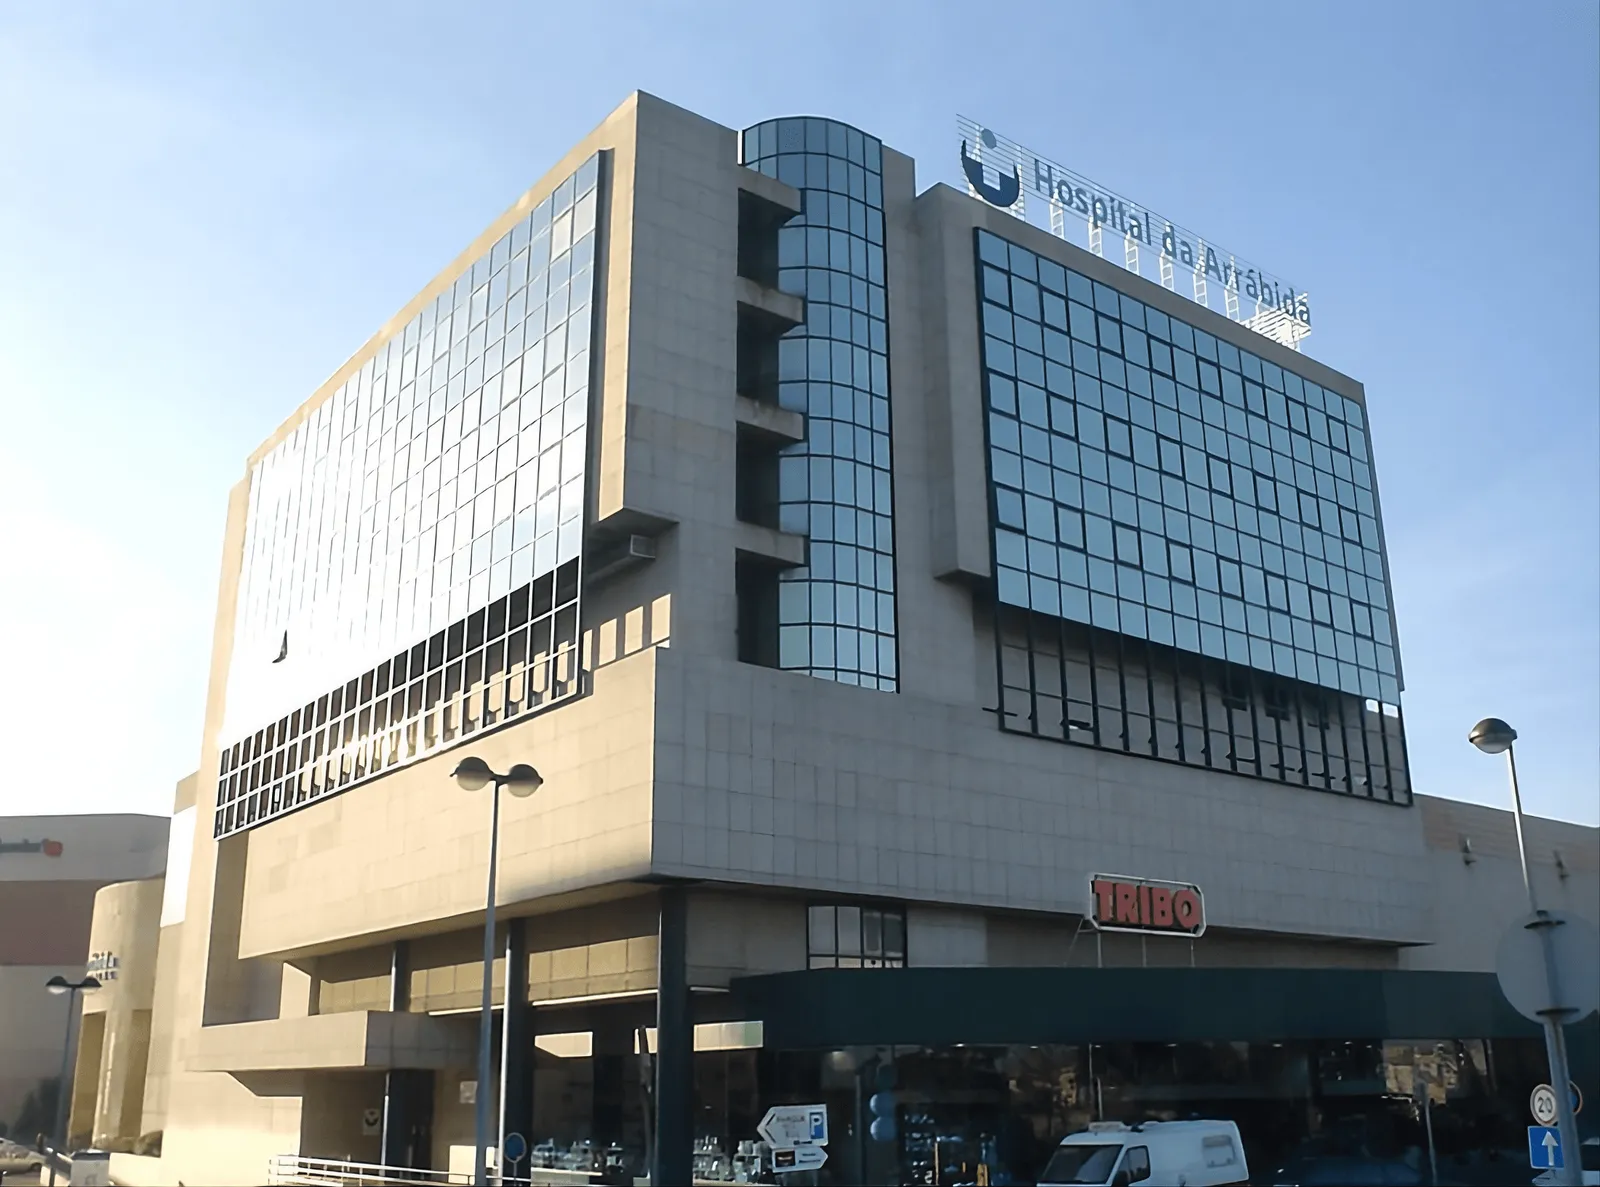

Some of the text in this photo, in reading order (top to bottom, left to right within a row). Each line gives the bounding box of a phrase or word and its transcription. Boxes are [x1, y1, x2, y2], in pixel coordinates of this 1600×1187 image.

[1034, 158, 1152, 245] Hospital
[1162, 224, 1194, 267] da
[1094, 880, 1202, 929] TRIBO
[1537, 1096, 1553, 1113] 20
[810, 1114, 823, 1136] P
